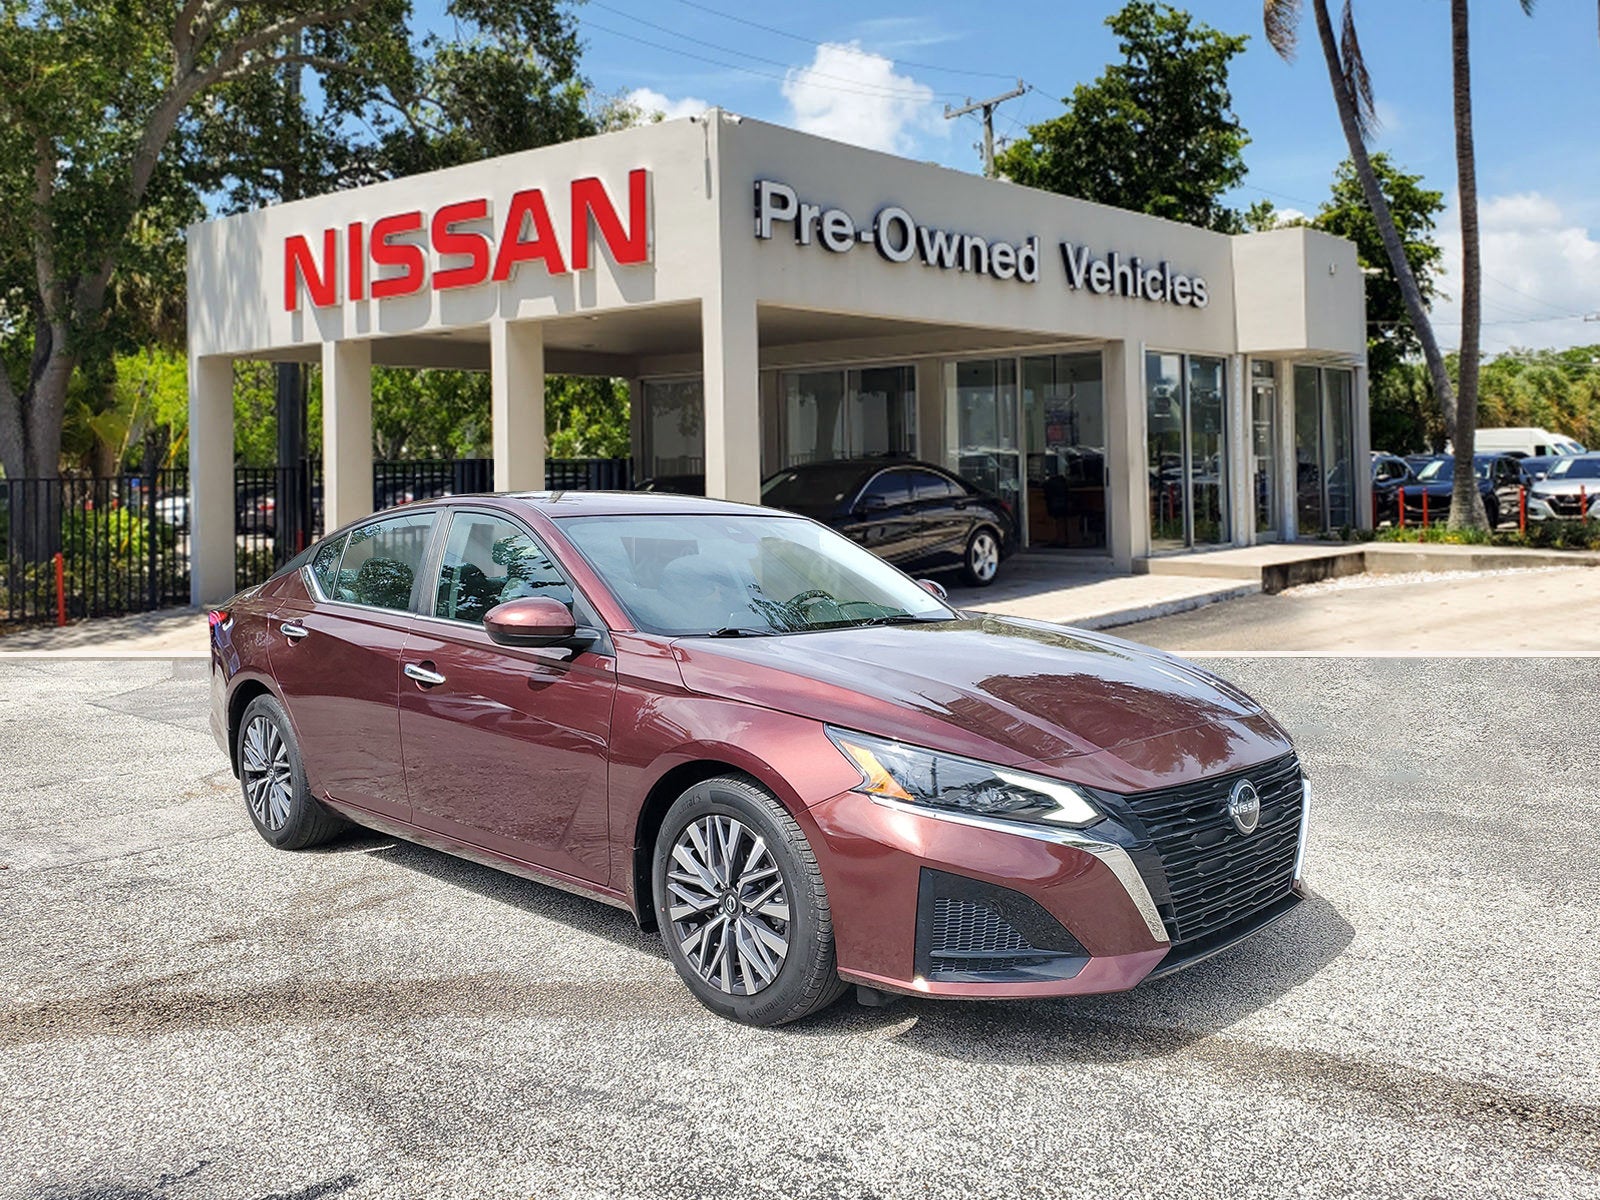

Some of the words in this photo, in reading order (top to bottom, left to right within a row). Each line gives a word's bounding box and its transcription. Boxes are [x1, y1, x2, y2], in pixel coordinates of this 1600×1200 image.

[285, 168, 648, 312] NISSAN
[755, 179, 1040, 284] Pre-Owned
[1060, 241, 1209, 308] Vehicles
[1231, 800, 1258, 816] NISS
